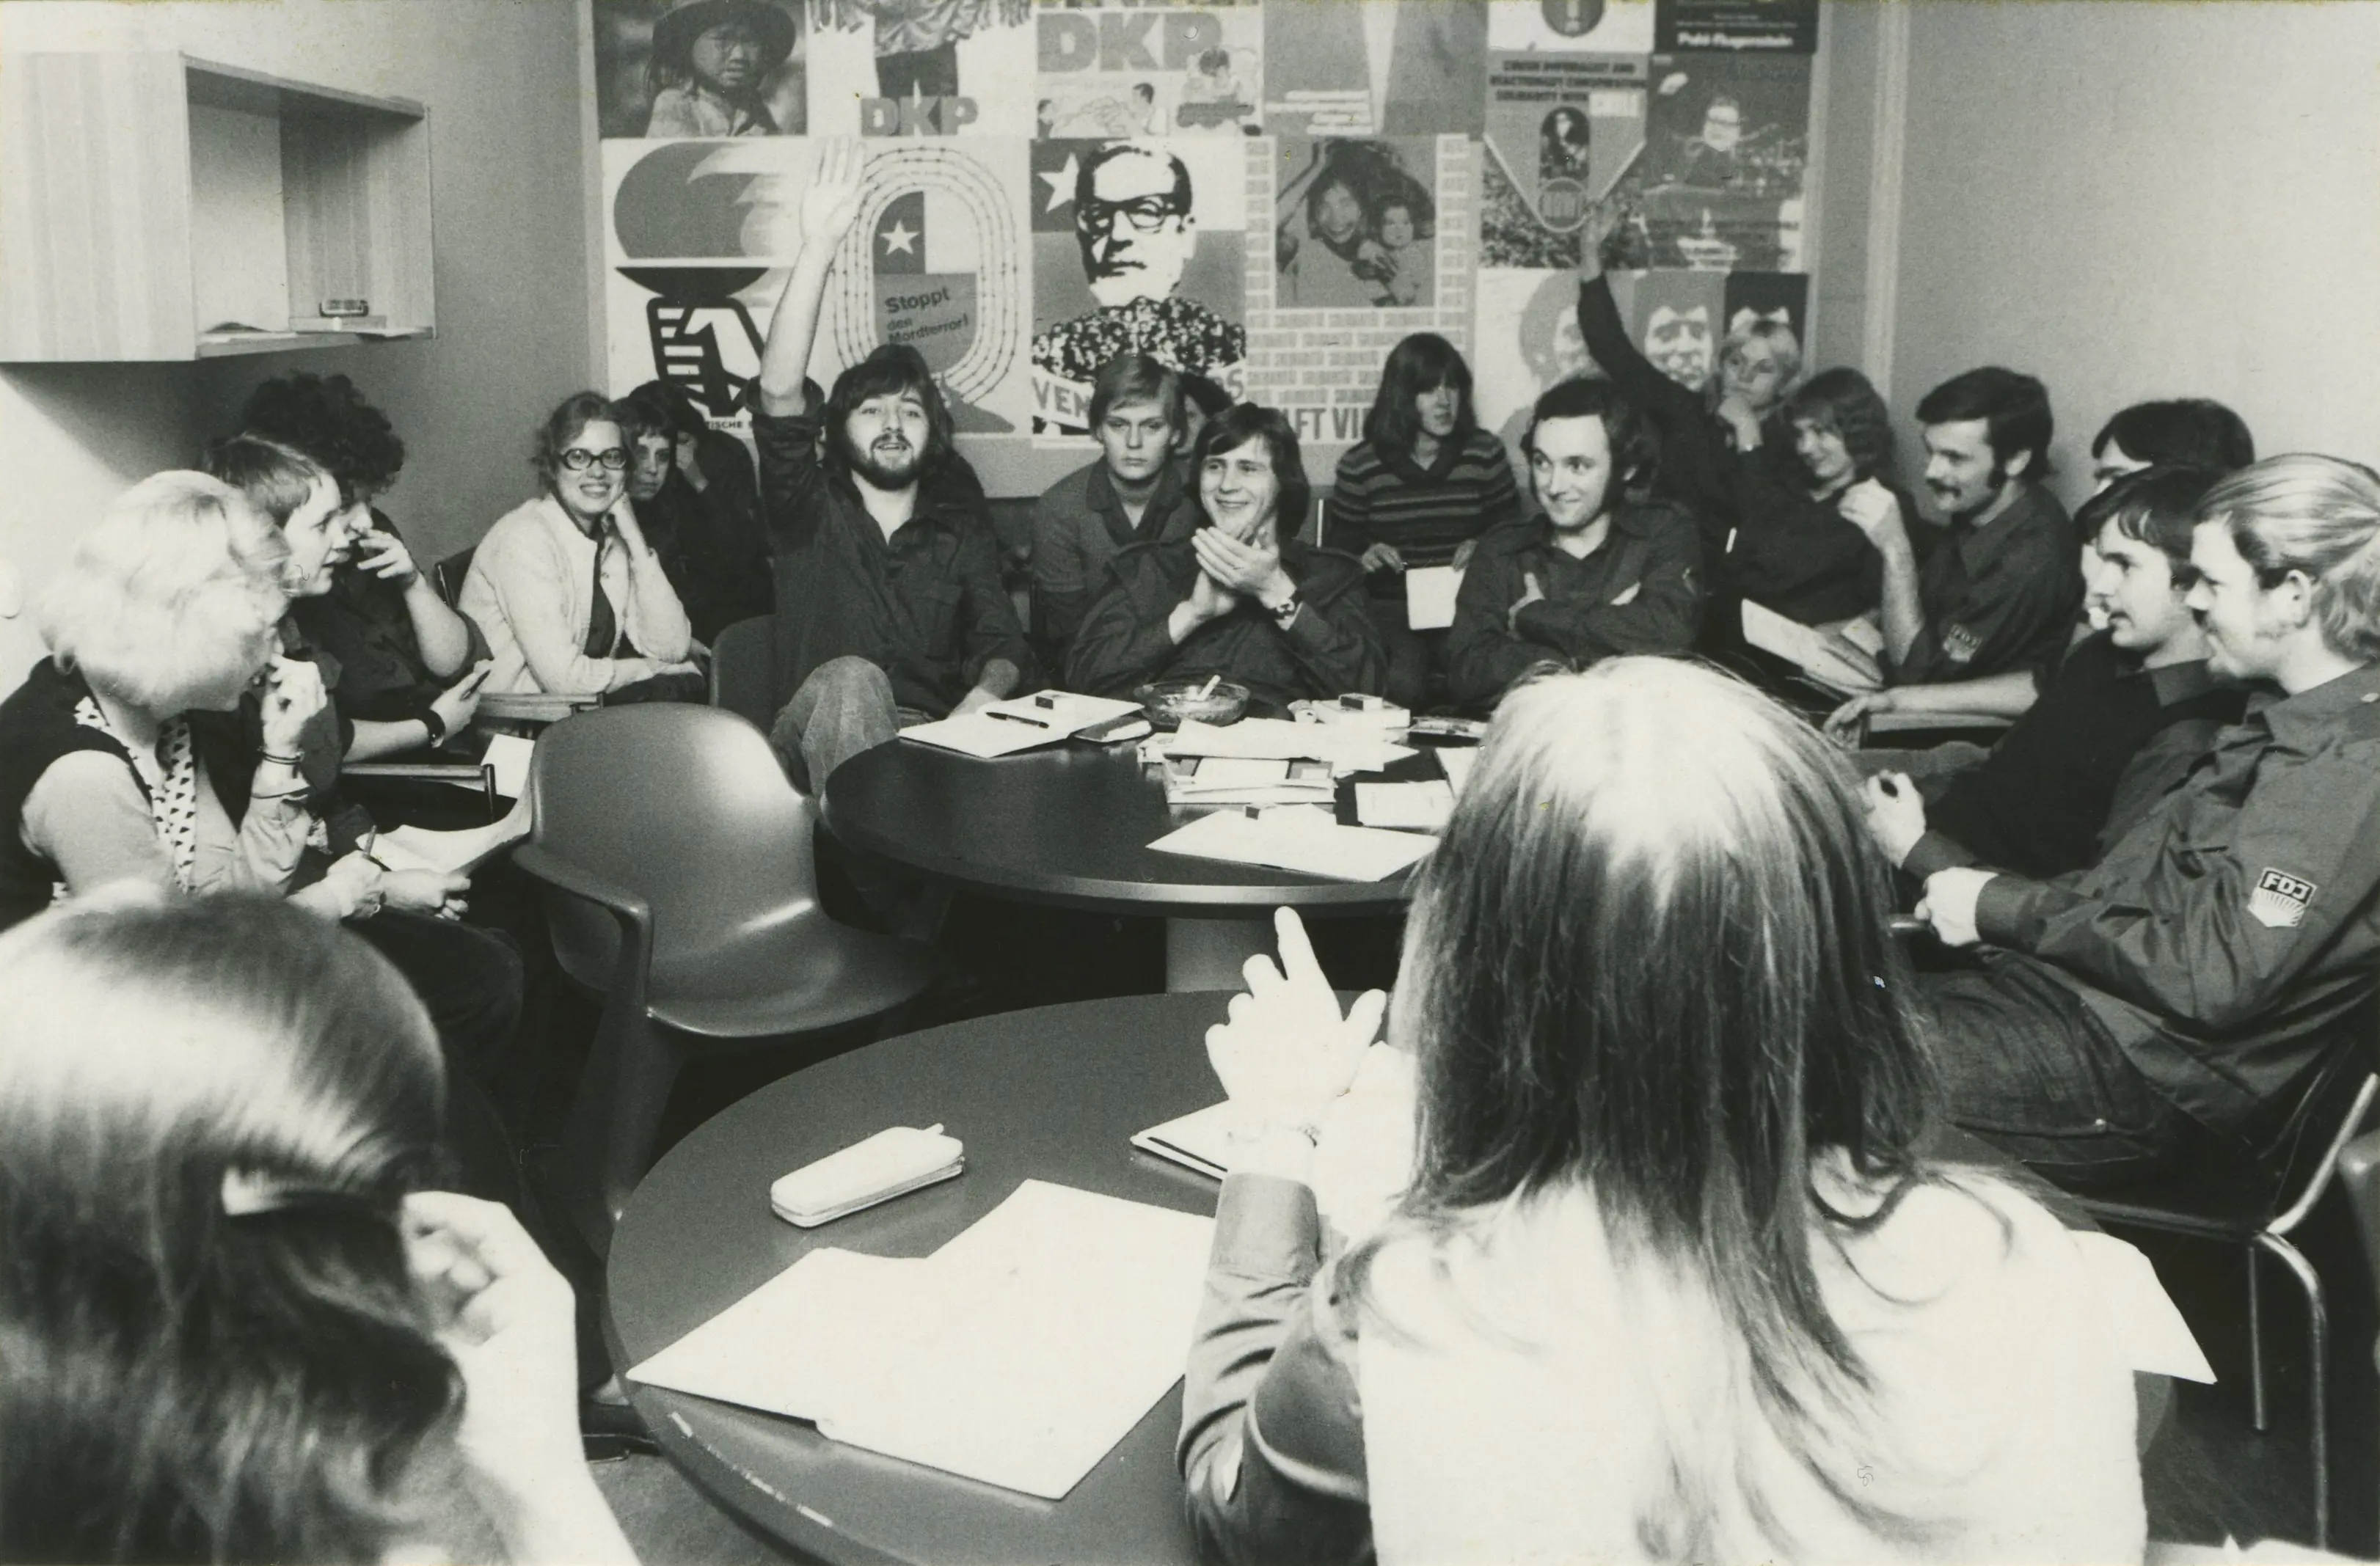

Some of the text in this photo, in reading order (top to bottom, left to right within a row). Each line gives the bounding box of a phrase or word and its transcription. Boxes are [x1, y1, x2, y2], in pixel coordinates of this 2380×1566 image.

[1037, 12, 1222, 71] DKP
[861, 97, 978, 136] DKP
[884, 286, 949, 313] Stoppt
[1285, 408, 1373, 440] FT VI
[2263, 873, 2310, 900] FDJ
